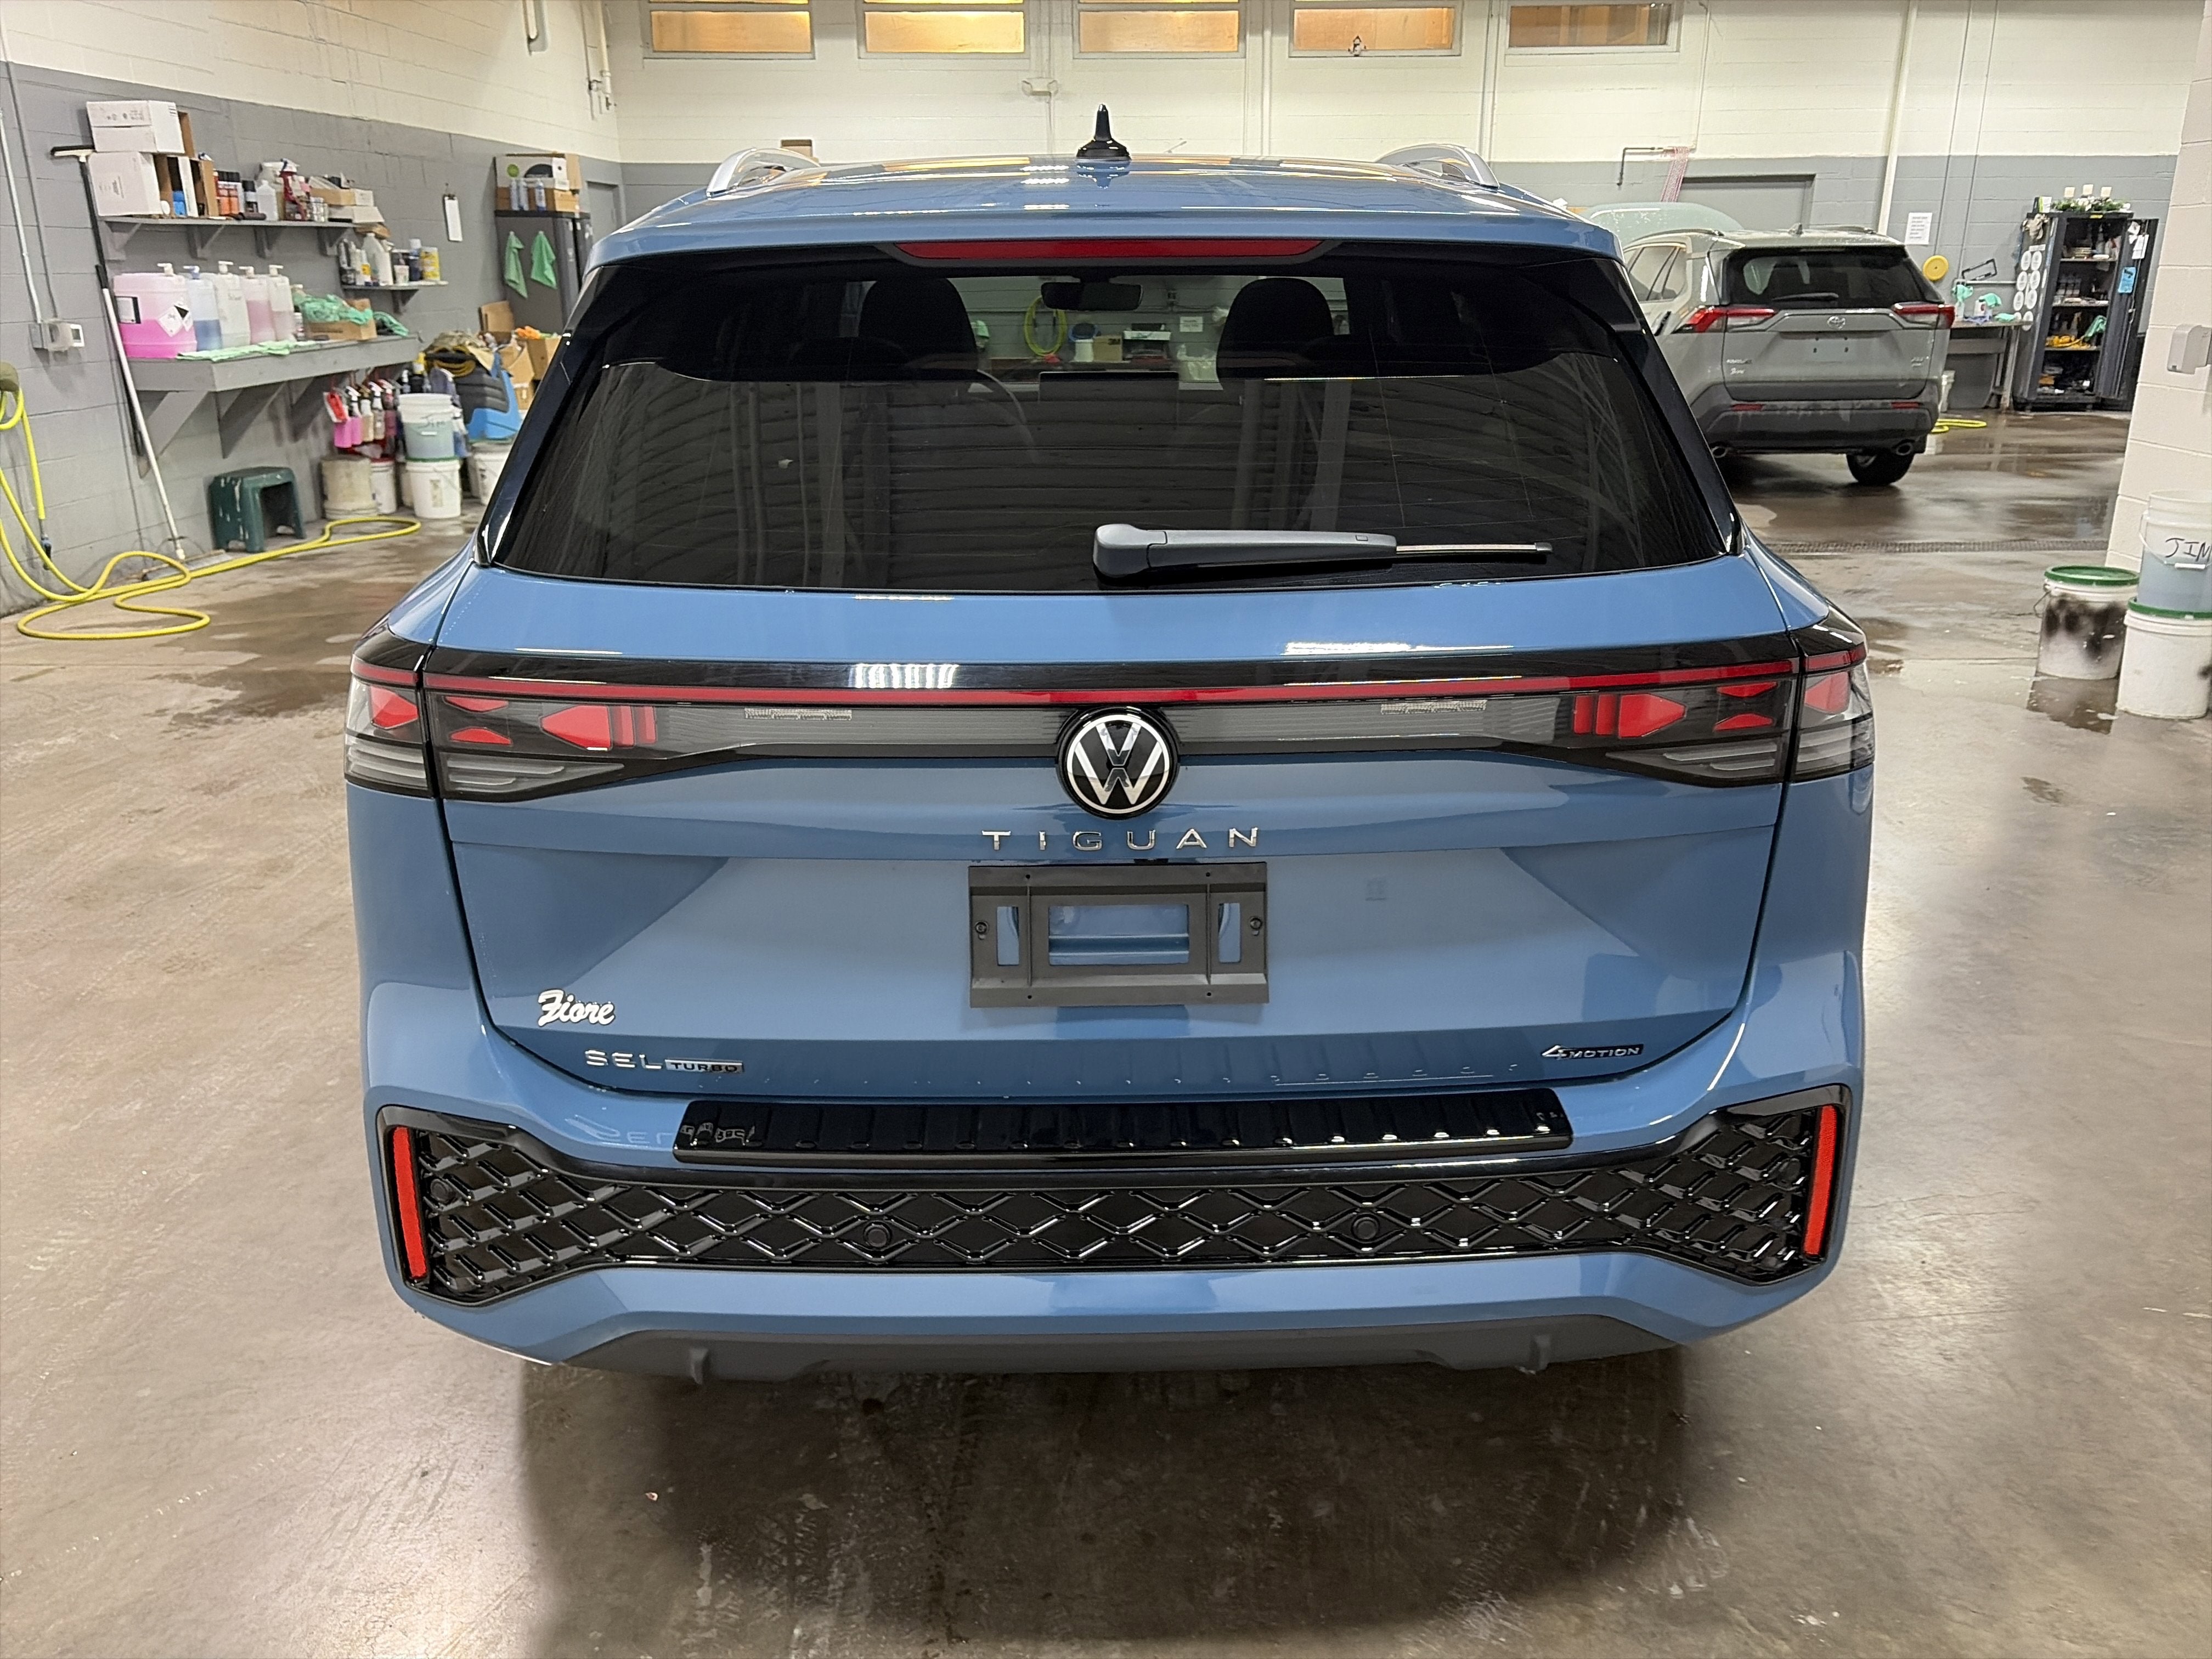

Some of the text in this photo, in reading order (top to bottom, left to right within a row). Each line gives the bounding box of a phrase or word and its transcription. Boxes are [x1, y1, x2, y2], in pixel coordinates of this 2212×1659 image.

[2165, 538, 2212, 562] JIM
[981, 827, 1259, 851] TIGUAN
[538, 988, 616, 1026] Fiore
[584, 1048, 738, 1073] SEL TURBO
[1541, 1045, 1640, 1060] 4MOTION
